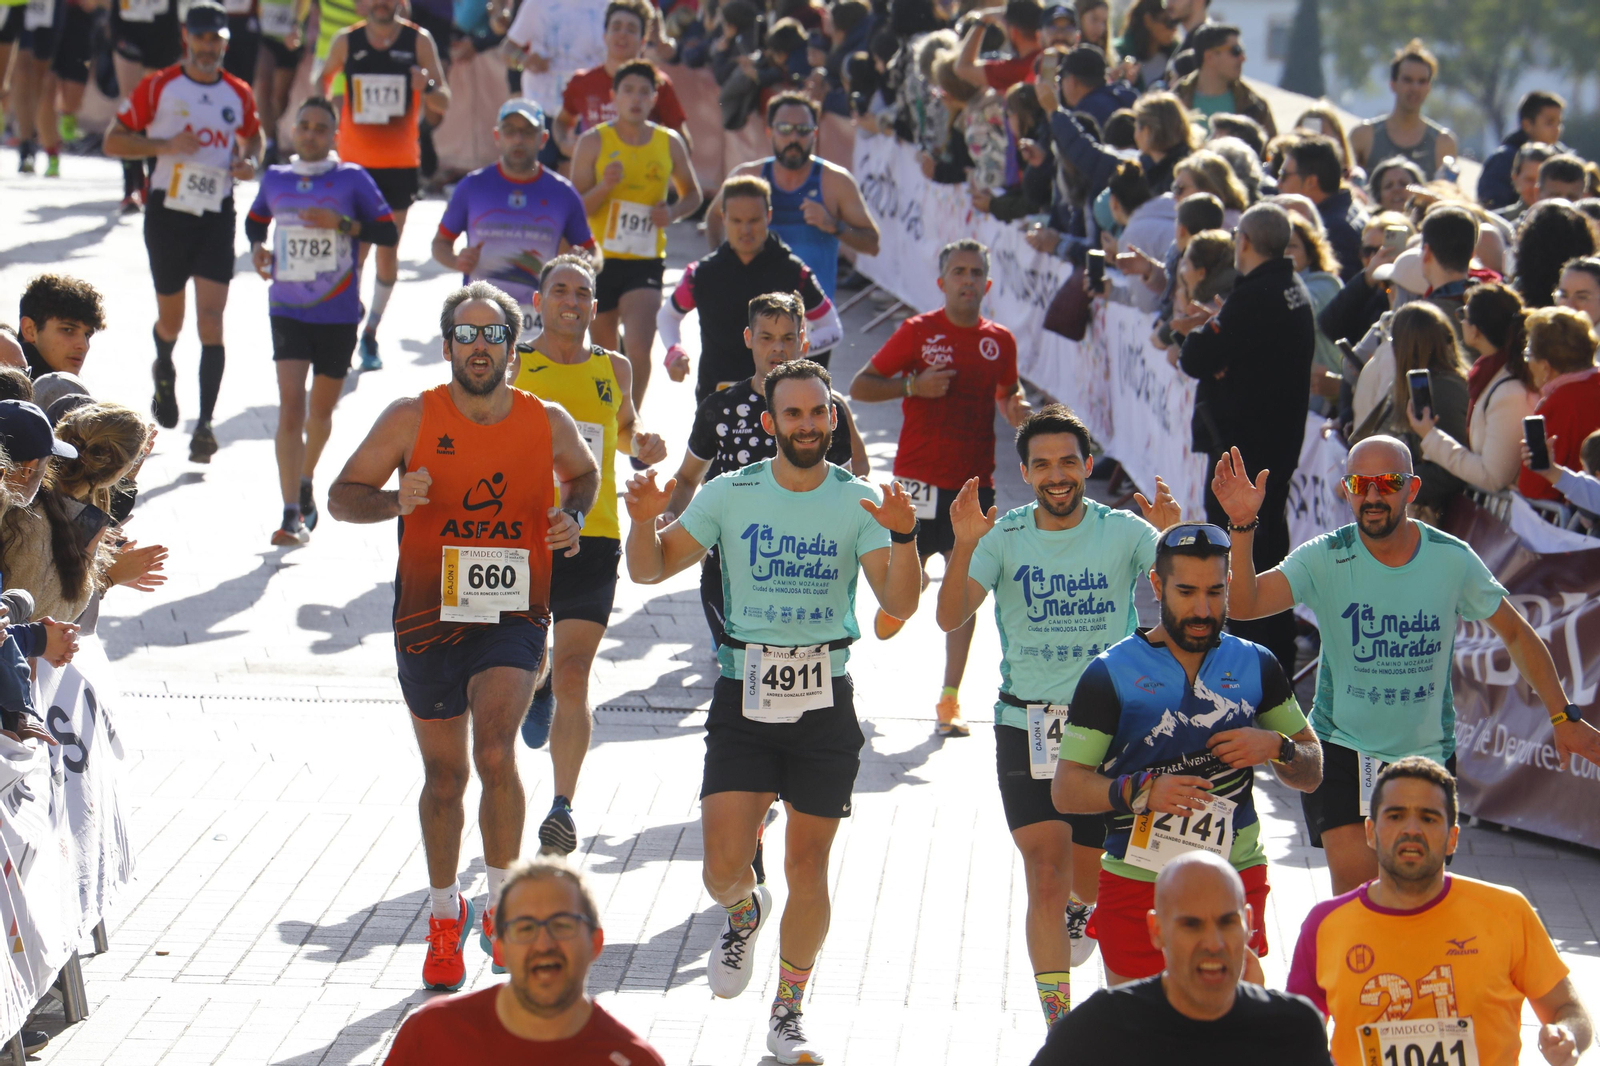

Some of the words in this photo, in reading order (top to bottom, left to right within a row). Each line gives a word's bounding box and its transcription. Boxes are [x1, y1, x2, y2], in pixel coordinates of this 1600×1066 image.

[364, 86, 400, 104] 1171
[187, 174, 217, 195] 586
[288, 239, 331, 257] 3782
[439, 518, 523, 540] ASFAS
[469, 550, 503, 559] IMDECO
[468, 563, 517, 590] 660
[752, 584, 768, 592] Ciudad
[775, 586, 802, 594] HINOJOSA
[1027, 625, 1043, 633] Ciudad
[1353, 665, 1371, 675] Ciudad
[1371, 667, 1378, 675] de
[1378, 667, 1407, 675] HINOJOSA
[1407, 666, 1418, 674] DEL
[1418, 664, 1434, 673] DUQUE
[1376, 659, 1402, 667] CAMINO
[749, 670, 757, 696] CAJÓN
[761, 661, 823, 691] 4911
[1153, 806, 1226, 846] 2141
[1154, 832, 1182, 844] ALEJANDRO
[1181, 839, 1205, 850] BORREGO
[1359, 964, 1473, 1024] 21
[1390, 1023, 1435, 1036] IMDECO
[1384, 1039, 1466, 1066] 1041
